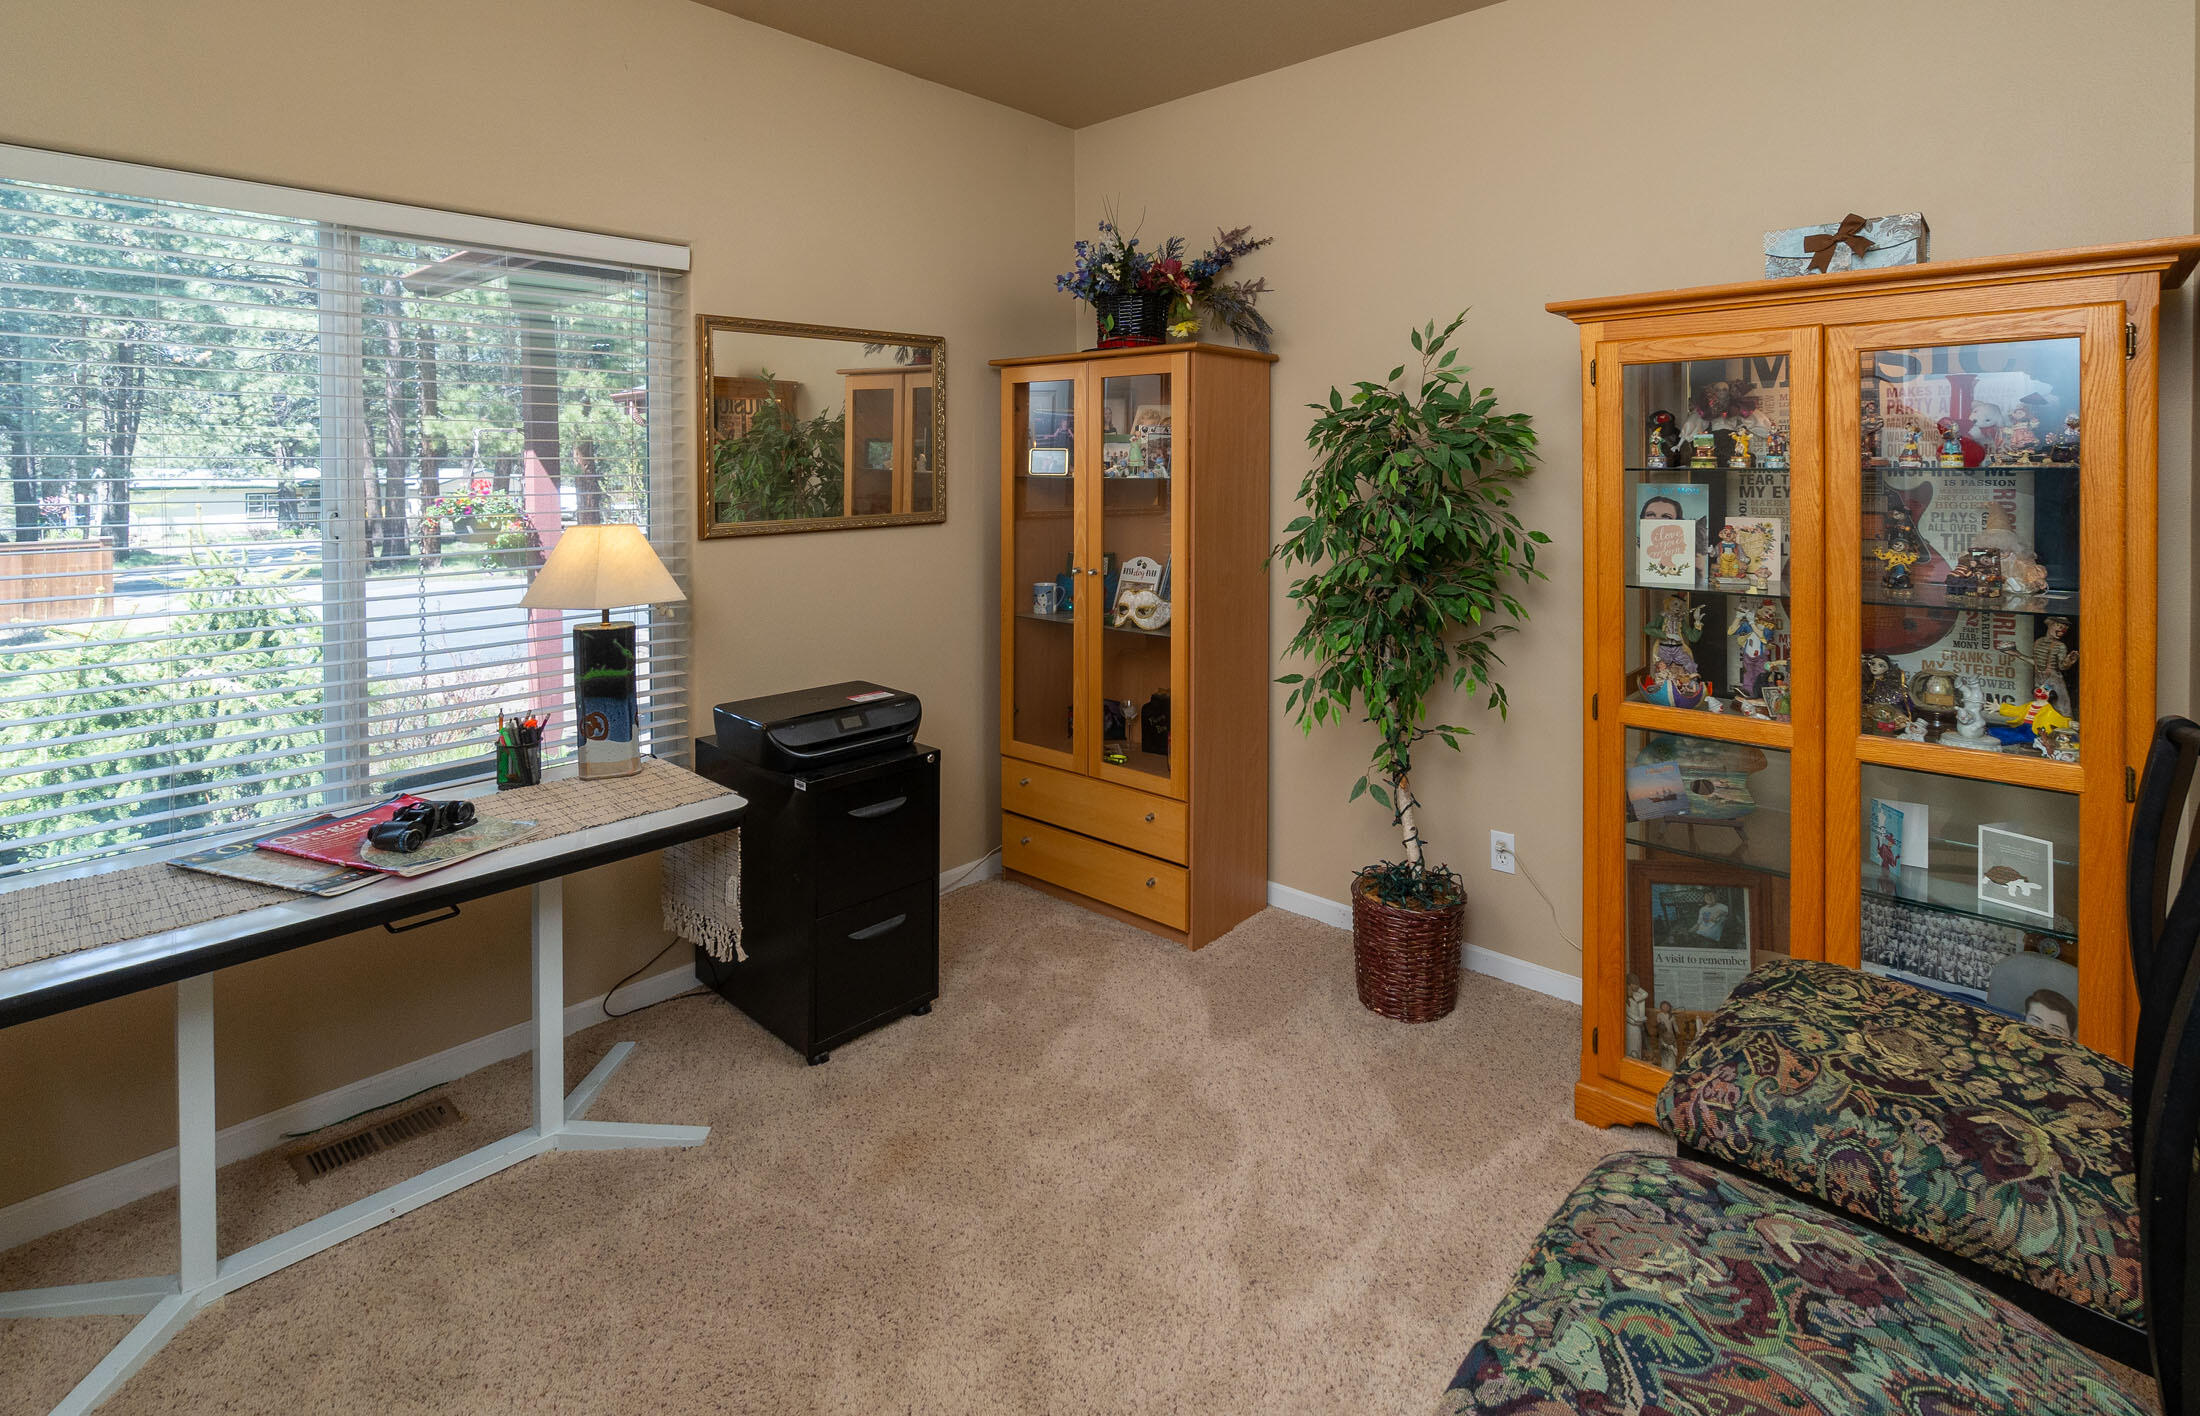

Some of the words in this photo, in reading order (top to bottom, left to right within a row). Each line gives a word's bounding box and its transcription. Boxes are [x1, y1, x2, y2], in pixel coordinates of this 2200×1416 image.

[1886, 386, 1932, 398] MAKES
[1886, 400, 1932, 415] PARTY
[1738, 474, 1774, 485] TEAR
[1960, 479, 2017, 487] PASSION
[1738, 486, 1766, 498] MY
[1772, 486, 1790, 498] EY
[1935, 501, 1988, 510] BIGGE
[1931, 512, 1978, 523] PLAYS
[1928, 523, 1945, 532] ALL
[1950, 524, 1978, 532] OVER
[1941, 533, 1977, 552] THE
[1959, 632, 1980, 641] HAR-
[1981, 611, 1991, 650] TARTED
[1952, 640, 1979, 649] MONY
[1921, 659, 1946, 672] MY
[1952, 663, 2017, 679] STEREO
[269, 817, 377, 844] Oregon
[1655, 953, 1663, 963] A
[1665, 953, 1685, 964] visit
[1687, 955, 1697, 964] to
[1699, 956, 1747, 966] remember
